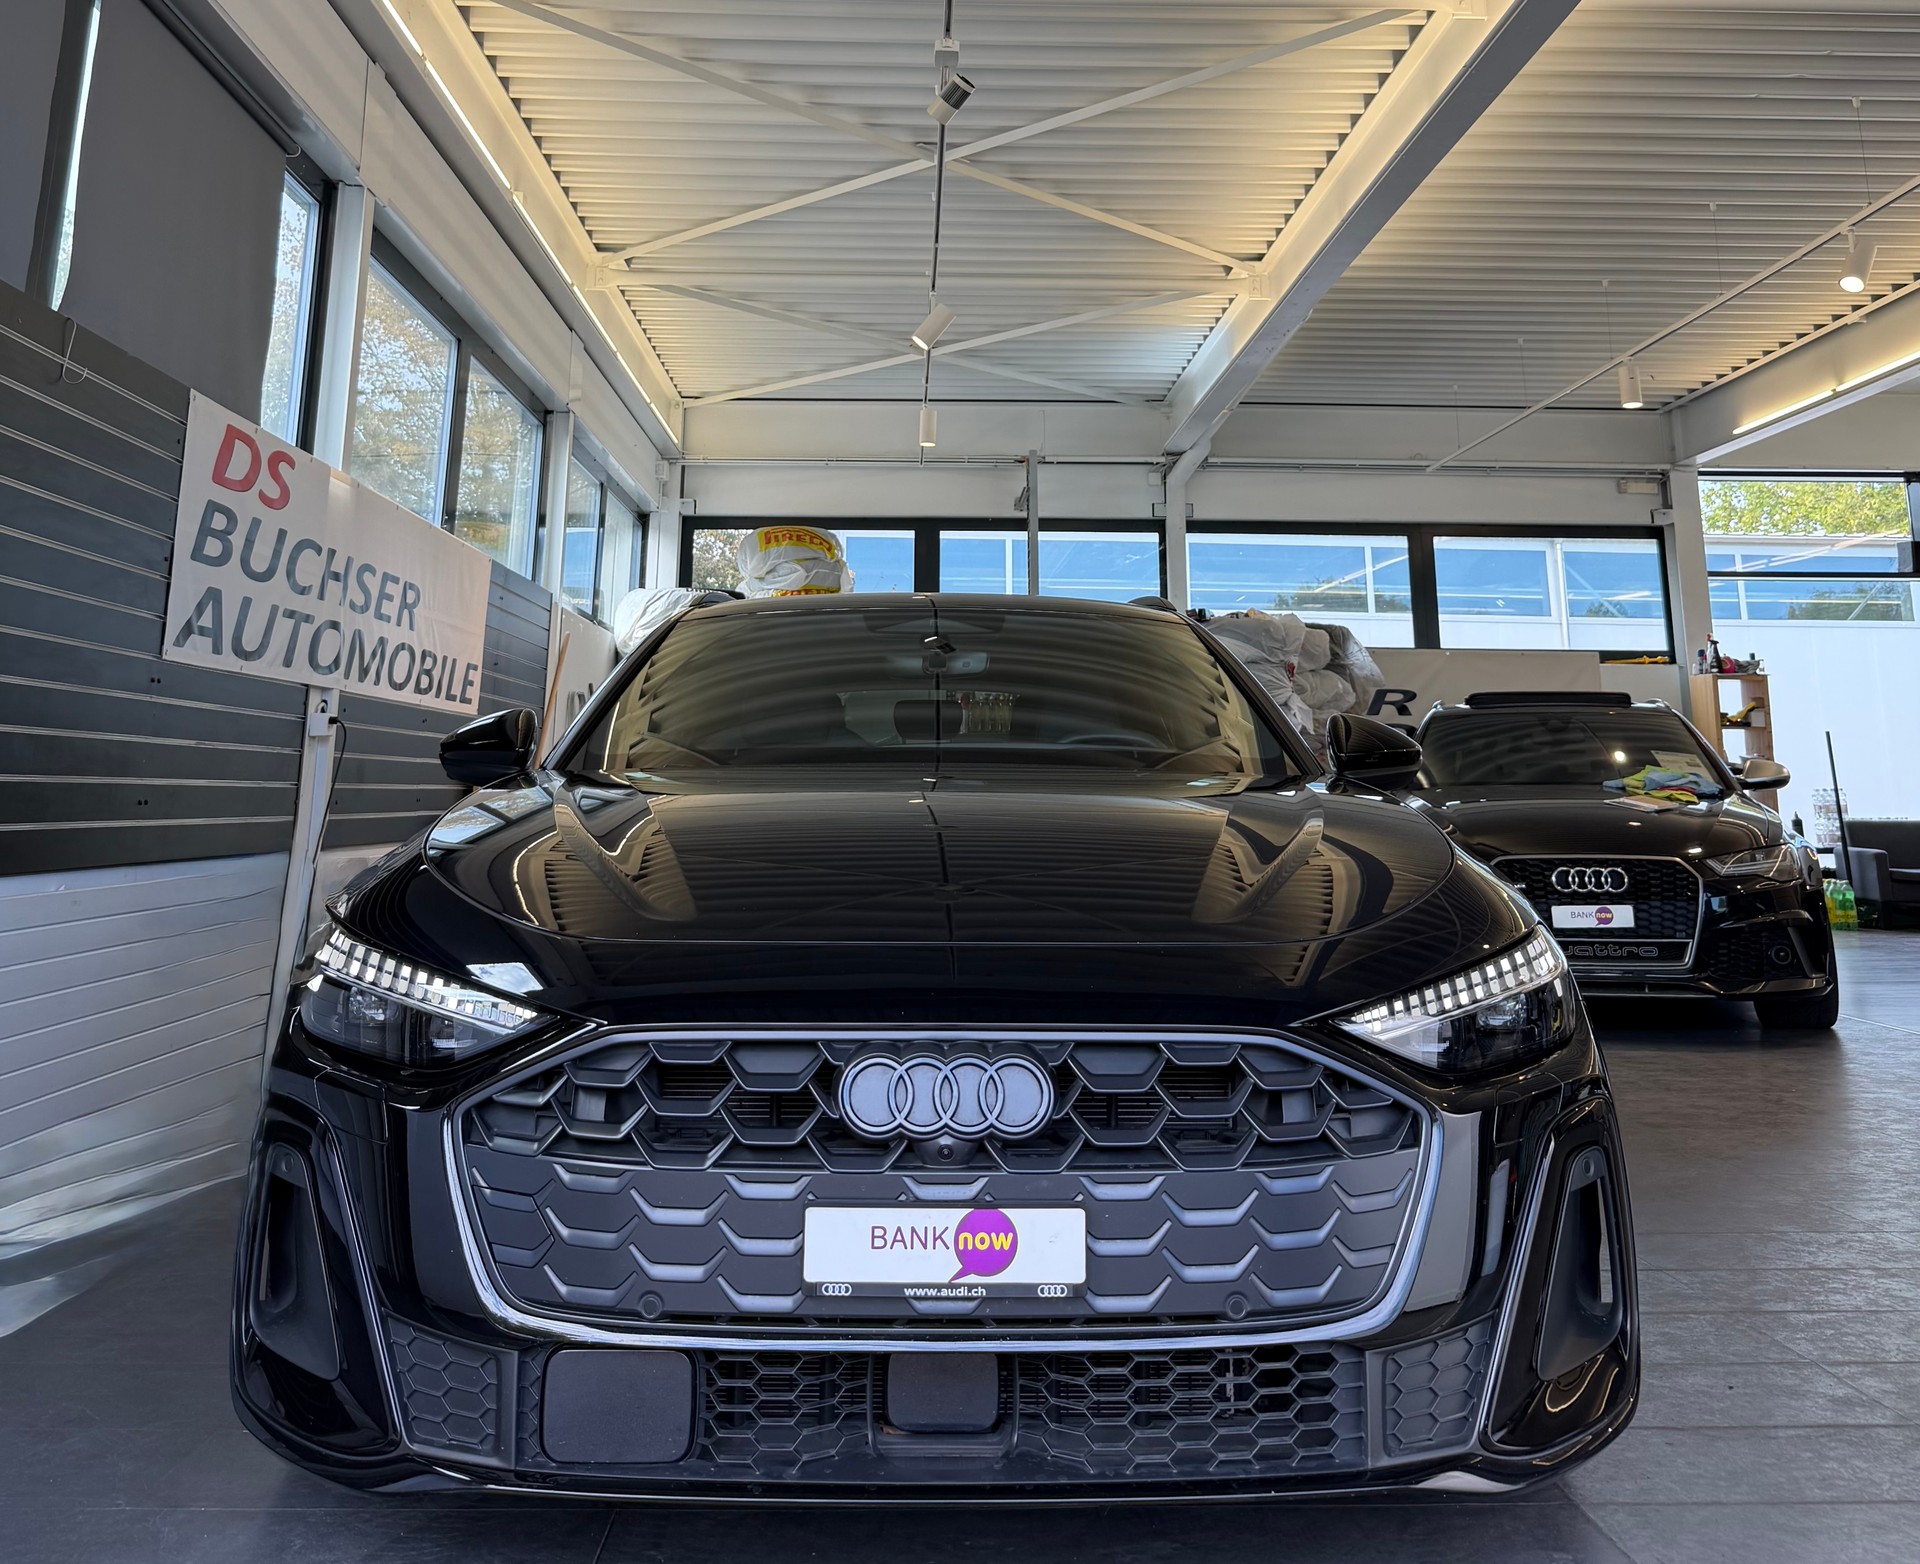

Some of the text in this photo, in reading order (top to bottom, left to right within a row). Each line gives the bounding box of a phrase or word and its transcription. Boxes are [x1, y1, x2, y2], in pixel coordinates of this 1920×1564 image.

[212, 424, 296, 511] DS
[190, 499, 421, 632] BUCHSER
[172, 586, 479, 705] AUTOMOBILE
[1570, 911, 1594, 919] BANK
[1563, 944, 1659, 957] uattro
[870, 1225, 1014, 1251] BANK now
[903, 1285, 987, 1297] www.audi.ch
